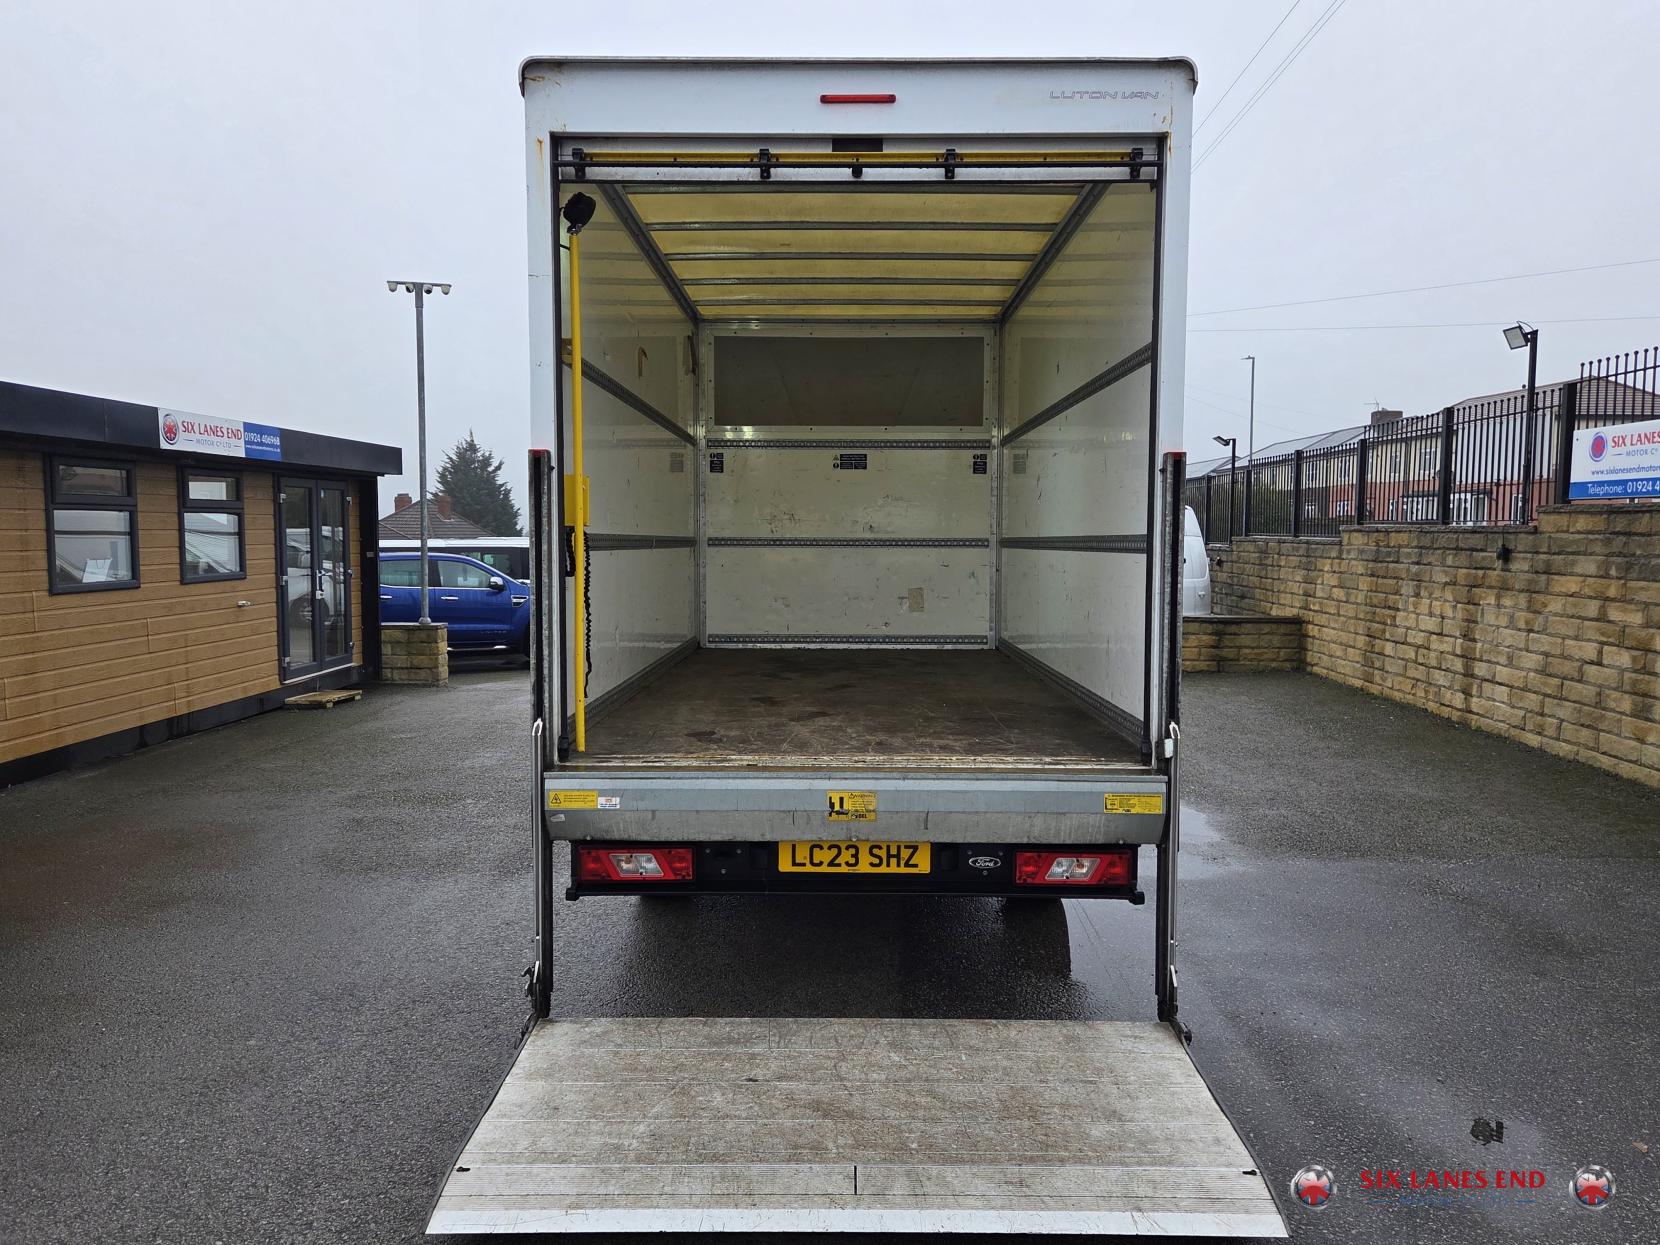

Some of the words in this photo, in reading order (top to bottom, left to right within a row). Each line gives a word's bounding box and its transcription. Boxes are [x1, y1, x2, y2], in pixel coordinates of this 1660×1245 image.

[1049, 90, 1118, 100] LUTON
[1120, 91, 1159, 100] VAN
[181, 420, 196, 434] SIX
[198, 423, 225, 438] LANES
[226, 427, 242, 440] END
[195, 438, 214, 447] MOTOR
[244, 432, 260, 443] 01924
[1611, 434, 1627, 448] SIX
[1625, 448, 1648, 457] MOTOR
[1587, 483, 1625, 496] Telephone:
[1626, 480, 1652, 493] 01924
[791, 843, 860, 868] LC23
[868, 844, 919, 868] SHZ
